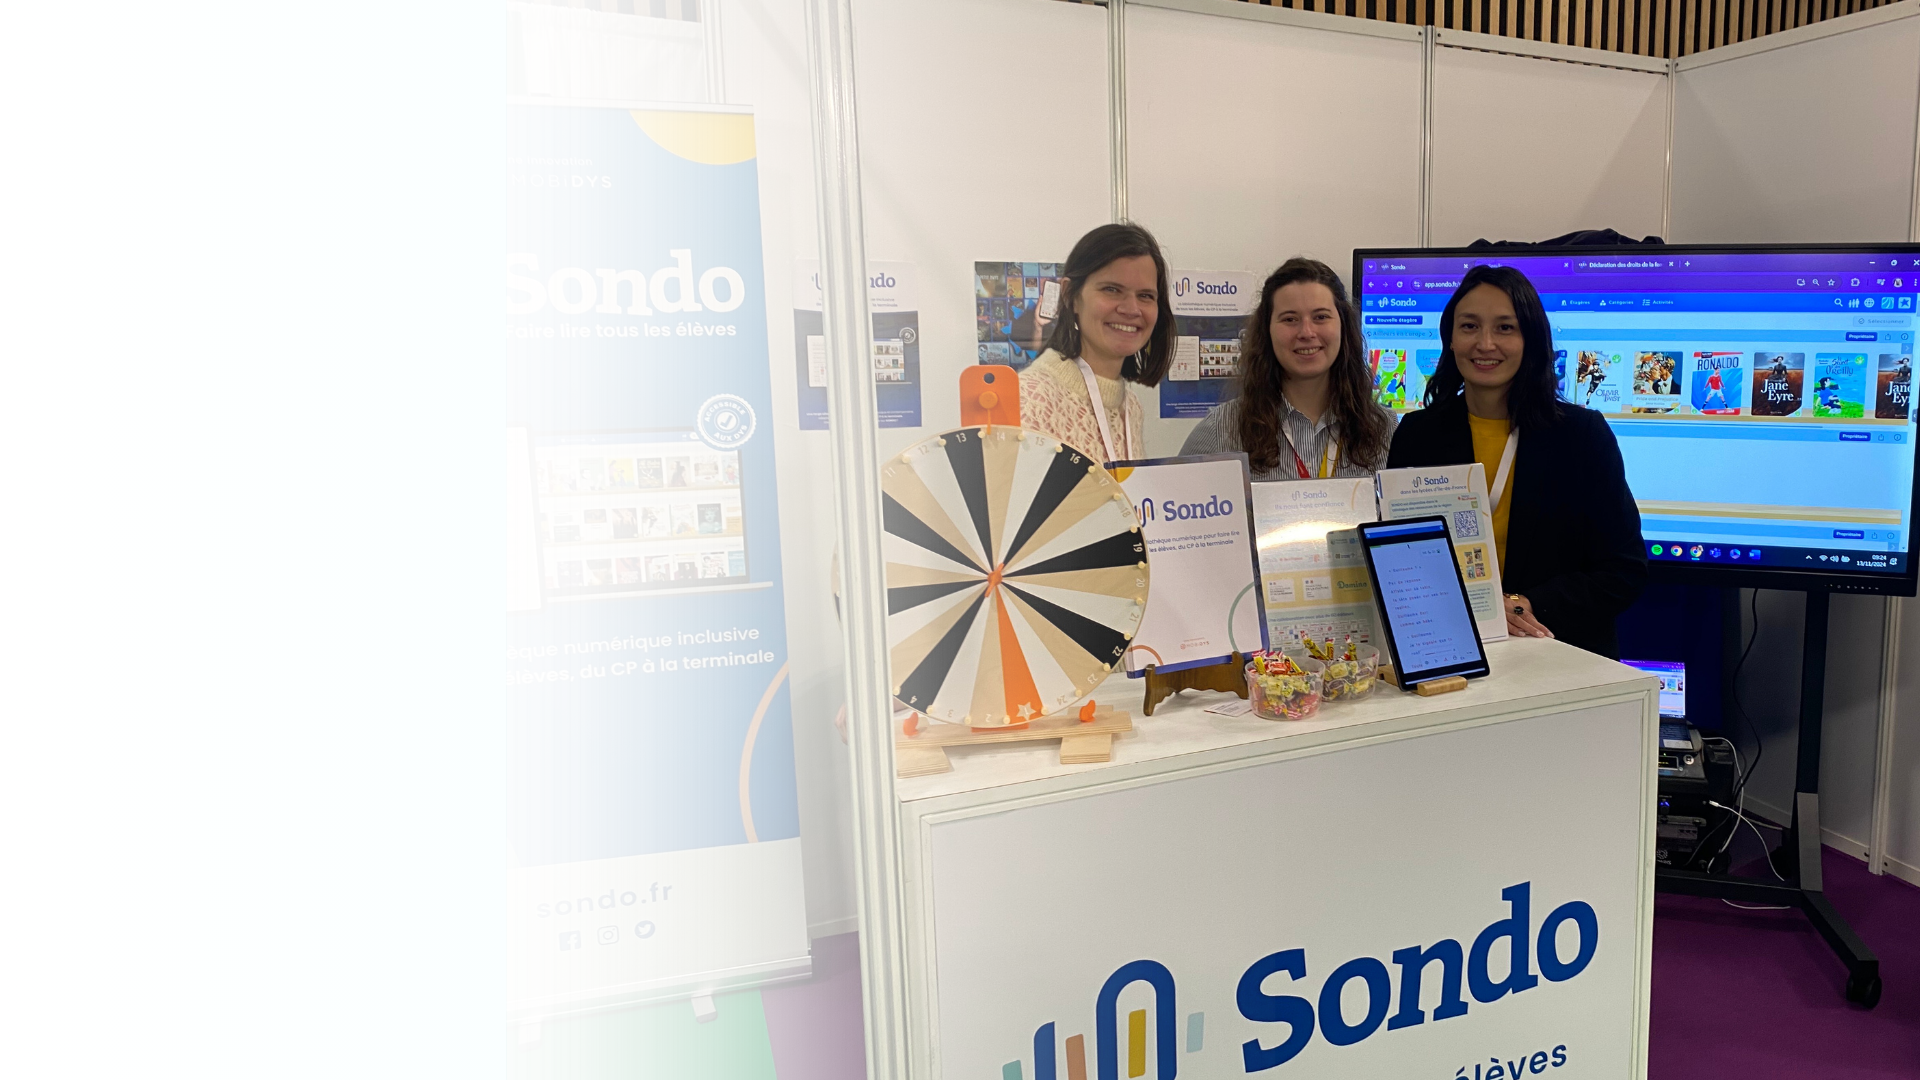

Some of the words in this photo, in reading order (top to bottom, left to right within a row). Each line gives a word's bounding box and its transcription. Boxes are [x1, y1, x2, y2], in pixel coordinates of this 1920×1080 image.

[506, 249, 745, 316] Sondo
[1196, 281, 1237, 295] Sondo
[1390, 298, 1417, 307] Sondo
[560, 322, 592, 338] lire
[595, 323, 639, 338] tous
[644, 322, 671, 337] les
[675, 321, 737, 337] élèves
[1697, 356, 1739, 371] RONALDO
[1760, 378, 1789, 394] Jane
[1767, 389, 1795, 404] Eyre
[704, 401, 747, 422] ACCESSIBLE
[713, 431, 733, 442] AUX
[733, 424, 748, 440] DYS
[955, 432, 967, 444] 13
[996, 432, 1006, 441] 14
[1034, 436, 1046, 447] 15
[918, 444, 931, 456] 12
[1069, 453, 1082, 465] 16
[1100, 477, 1111, 488] 17
[1424, 475, 1449, 485] Sondo
[1303, 490, 1328, 499] Sondo
[1121, 506, 1131, 518] 18
[1163, 495, 1233, 521] Sondo
[1133, 542, 1143, 553] 19
[1136, 577, 1146, 588] 20
[1129, 612, 1140, 623] 21
[564, 635, 673, 657] numérique
[677, 626, 760, 646] inclusive
[1111, 645, 1124, 657] 22
[579, 662, 605, 679] du
[610, 660, 637, 676] CP
[642, 658, 655, 673] à
[660, 657, 678, 672] la
[682, 649, 775, 670] terminale
[1087, 672, 1099, 685] 23
[910, 695, 918, 704] 4
[1056, 694, 1068, 706] 24
[947, 708, 954, 718] 3
[985, 713, 992, 723] 2
[536, 881, 673, 918] sondo.fr
[1236, 881, 1599, 1074] Sondo
